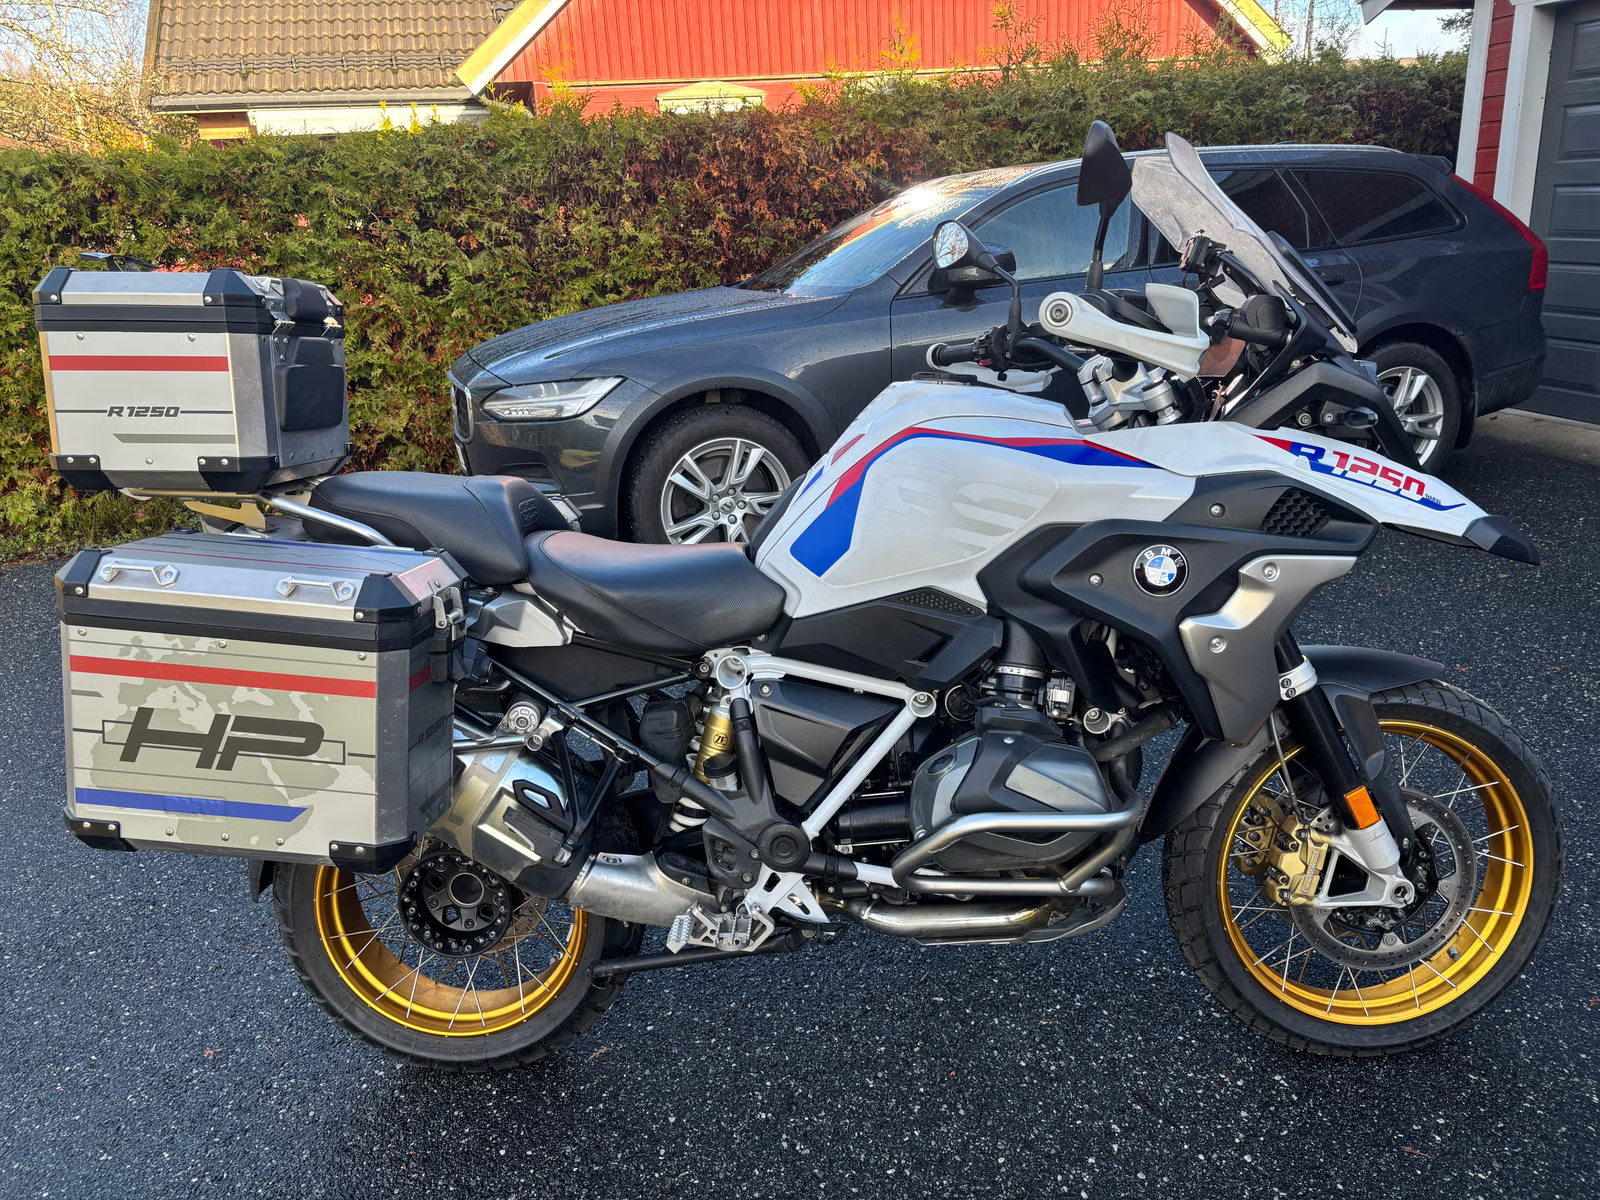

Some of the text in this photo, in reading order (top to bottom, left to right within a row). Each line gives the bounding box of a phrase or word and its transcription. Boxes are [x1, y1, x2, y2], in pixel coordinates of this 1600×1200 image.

[1143, 547, 1185, 568] BMW
[119, 706, 325, 771] HP
[715, 735, 726, 744] ZF
